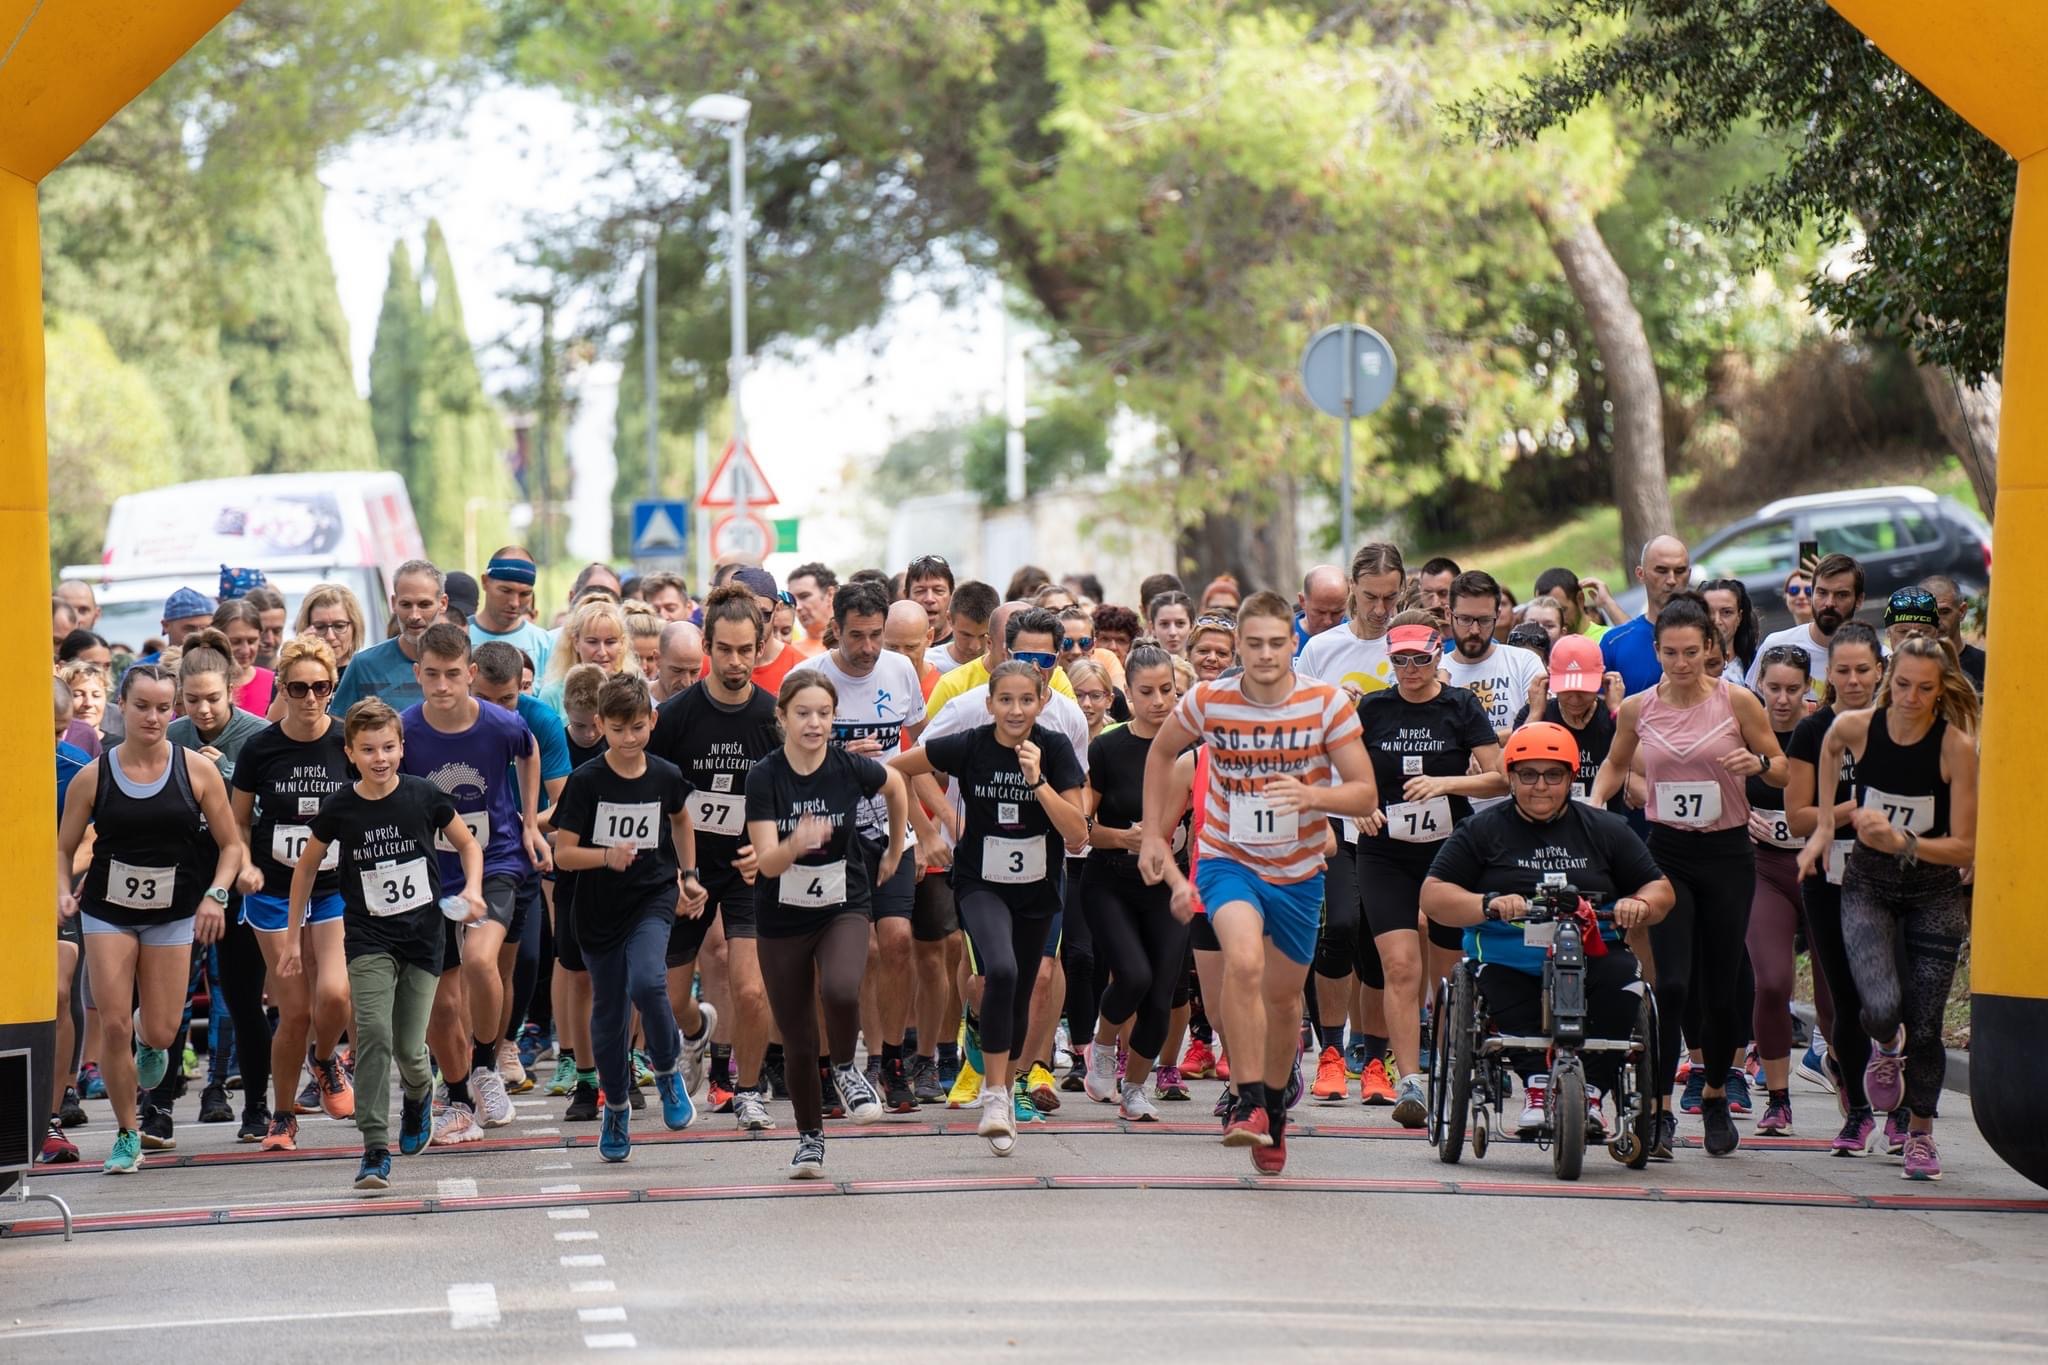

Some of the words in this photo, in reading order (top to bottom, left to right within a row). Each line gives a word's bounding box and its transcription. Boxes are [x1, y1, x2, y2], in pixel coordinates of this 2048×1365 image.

[1470, 676, 1509, 693] RUN
[1477, 692, 1508, 704] OCAL
[1486, 704, 1508, 717] ND
[1381, 741, 1392, 752] MA
[1393, 740, 1402, 752] NI
[693, 759, 704, 770] MA
[705, 758, 714, 770] NI
[275, 781, 286, 793] MA
[287, 781, 296, 793] NI
[975, 784, 986, 798] MA
[987, 785, 997, 798] NI
[700, 802, 730, 825] 97
[1673, 793, 1703, 818] 37
[1883, 803, 1914, 827] 77
[608, 815, 649, 839] 106
[1254, 809, 1274, 833] 11
[1404, 810, 1437, 836] 74
[353, 848, 363, 861] MA
[363, 847, 372, 860] NI
[1008, 851, 1024, 873] 3
[1518, 859, 1530, 869] MA
[1531, 860, 1540, 870] NI
[125, 876, 157, 900] 93
[382, 874, 416, 904] 36
[806, 877, 824, 898] 4
